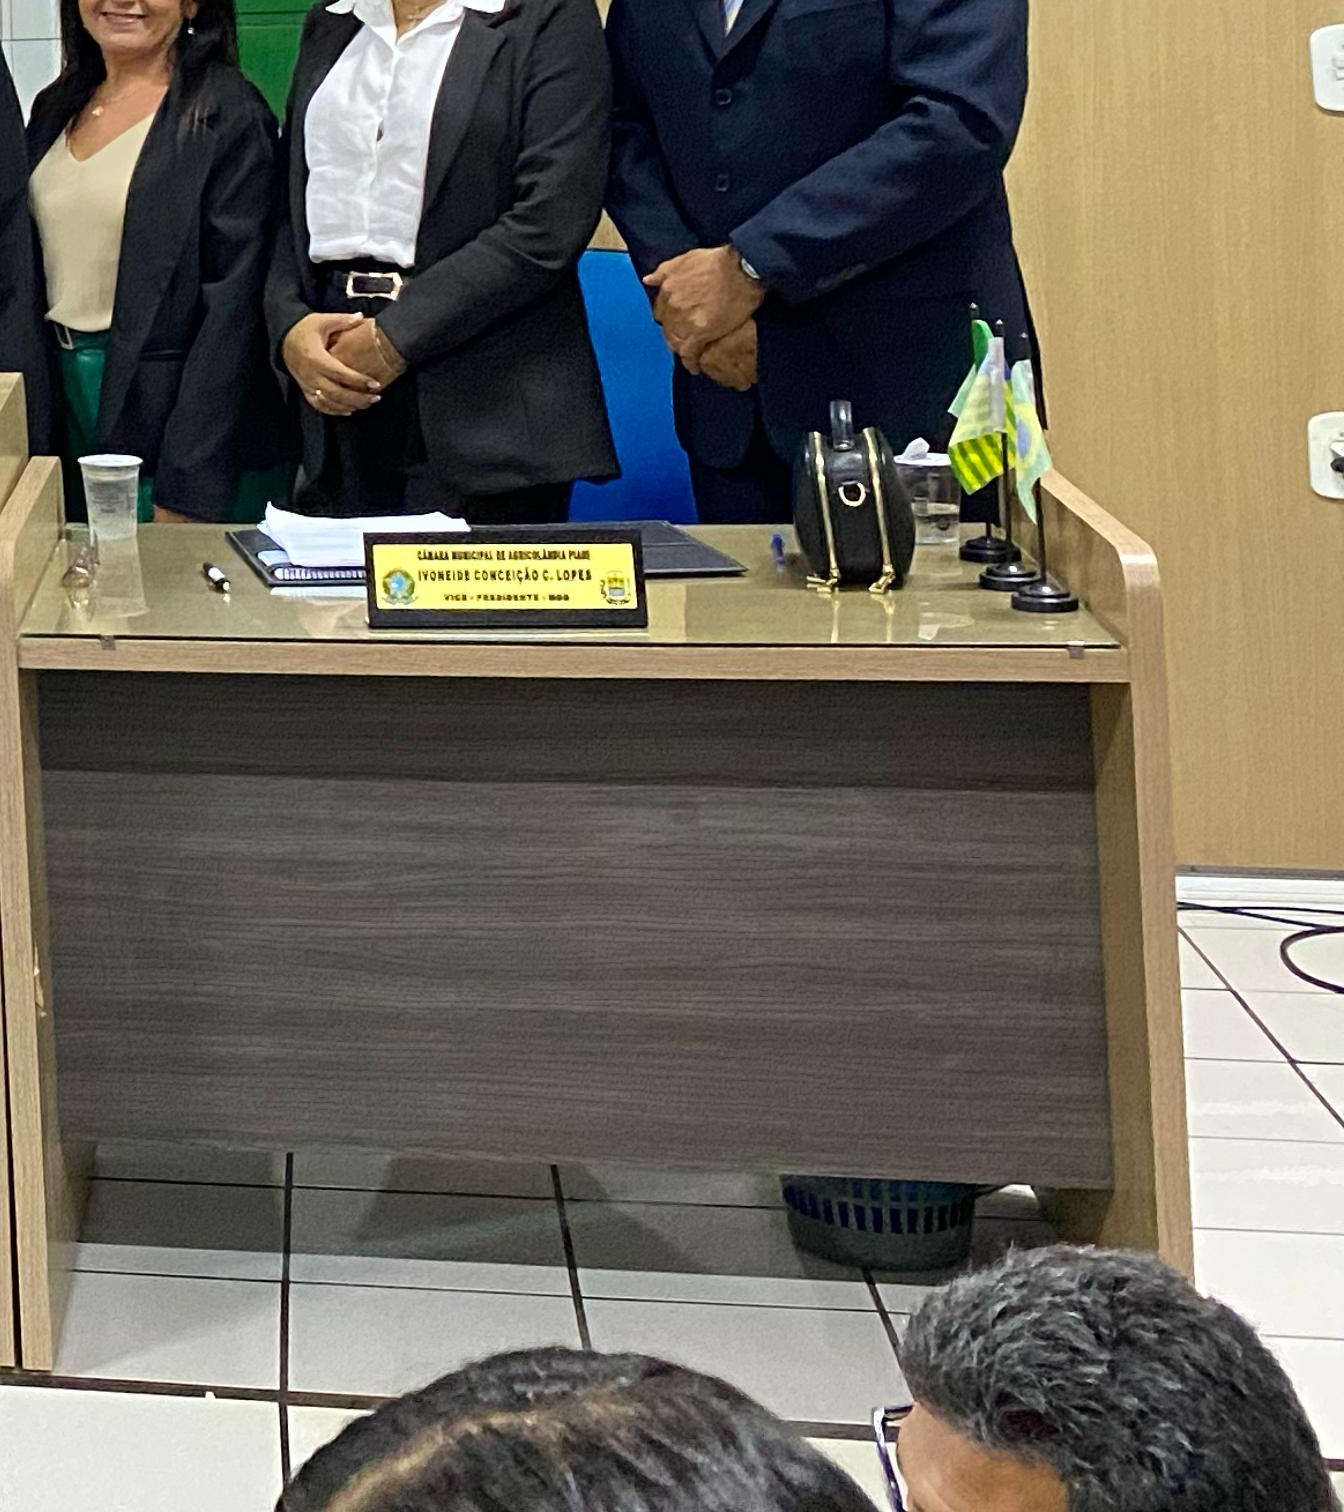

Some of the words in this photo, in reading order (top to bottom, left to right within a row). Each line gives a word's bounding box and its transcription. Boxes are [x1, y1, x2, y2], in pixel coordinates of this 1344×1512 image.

[452, 550, 493, 561] MUNICIPAL
[418, 569, 470, 582] IVONEIDE
[474, 567, 539, 584] CONCEIÇÃO
[556, 569, 592, 582] LOPES
